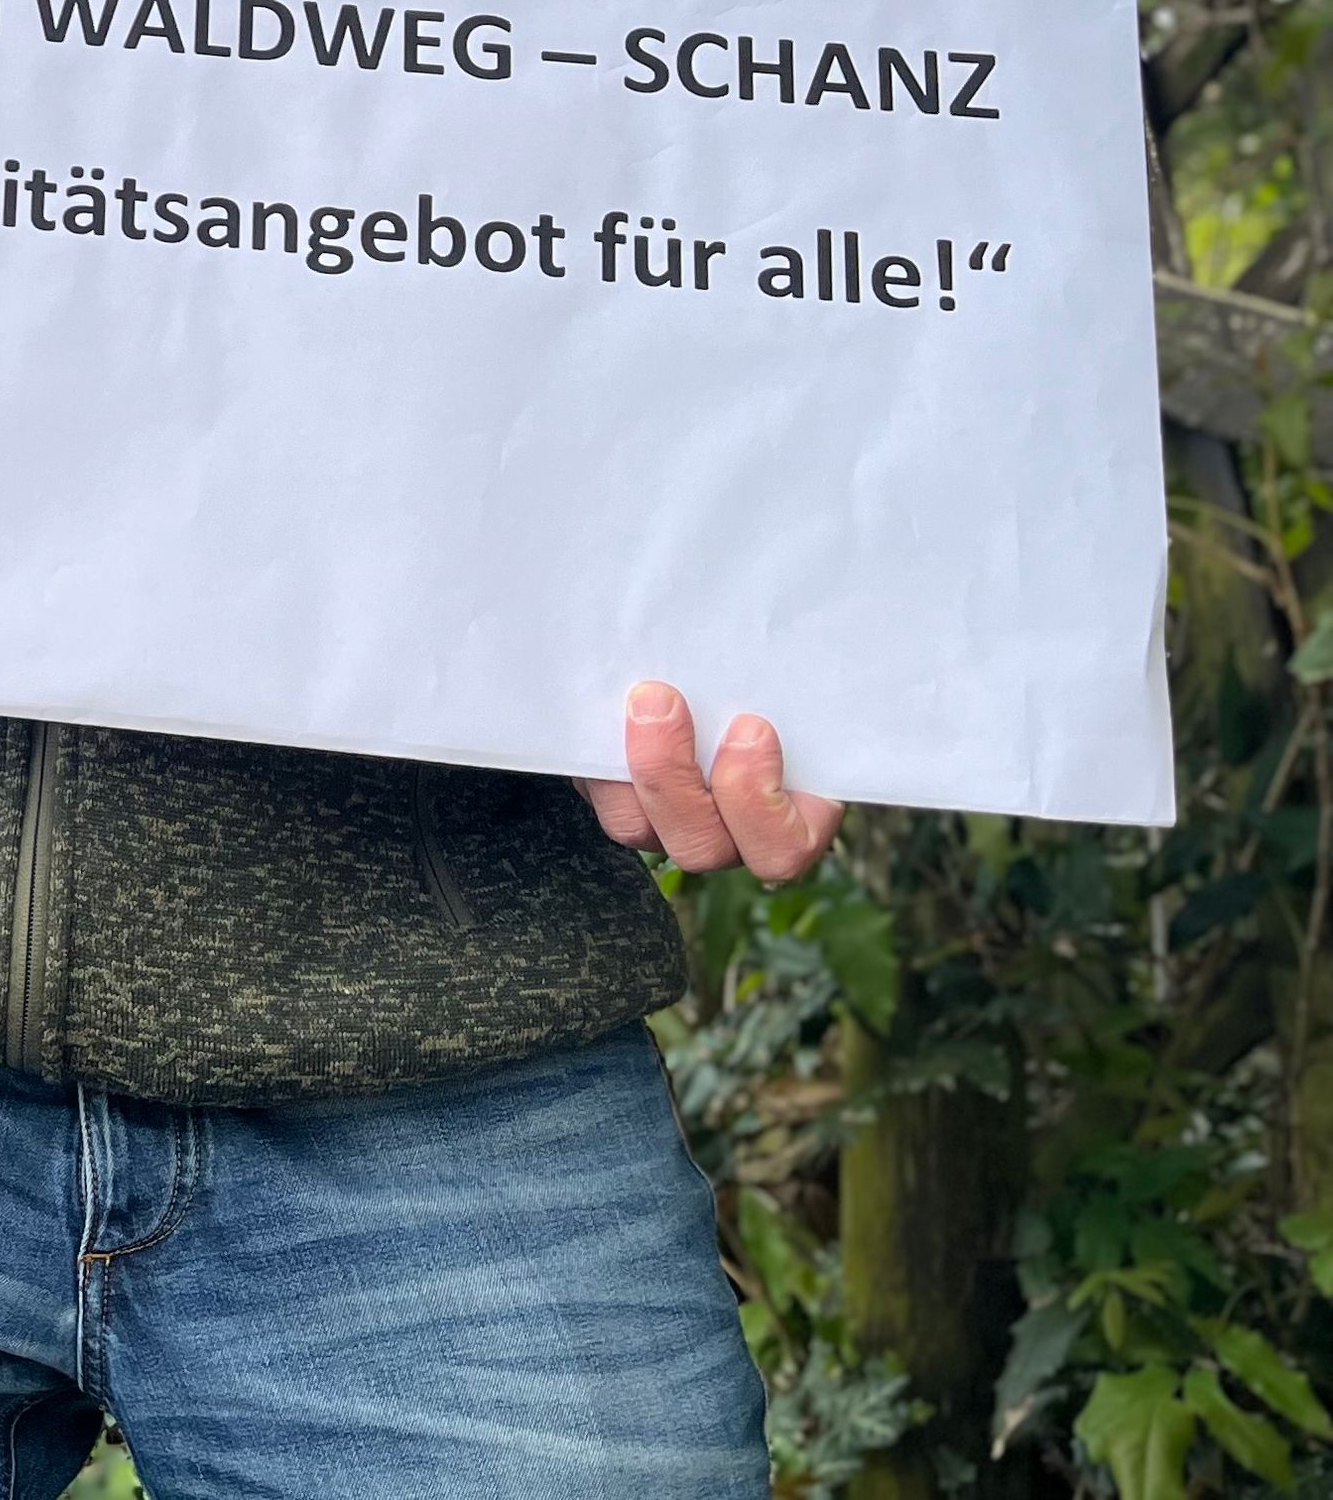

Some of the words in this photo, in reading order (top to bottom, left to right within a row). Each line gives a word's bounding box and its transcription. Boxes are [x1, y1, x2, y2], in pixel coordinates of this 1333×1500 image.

[625, 28, 999, 119] SCHANZ
[594, 212, 725, 290] für
[758, 229, 1011, 311] alle!“
